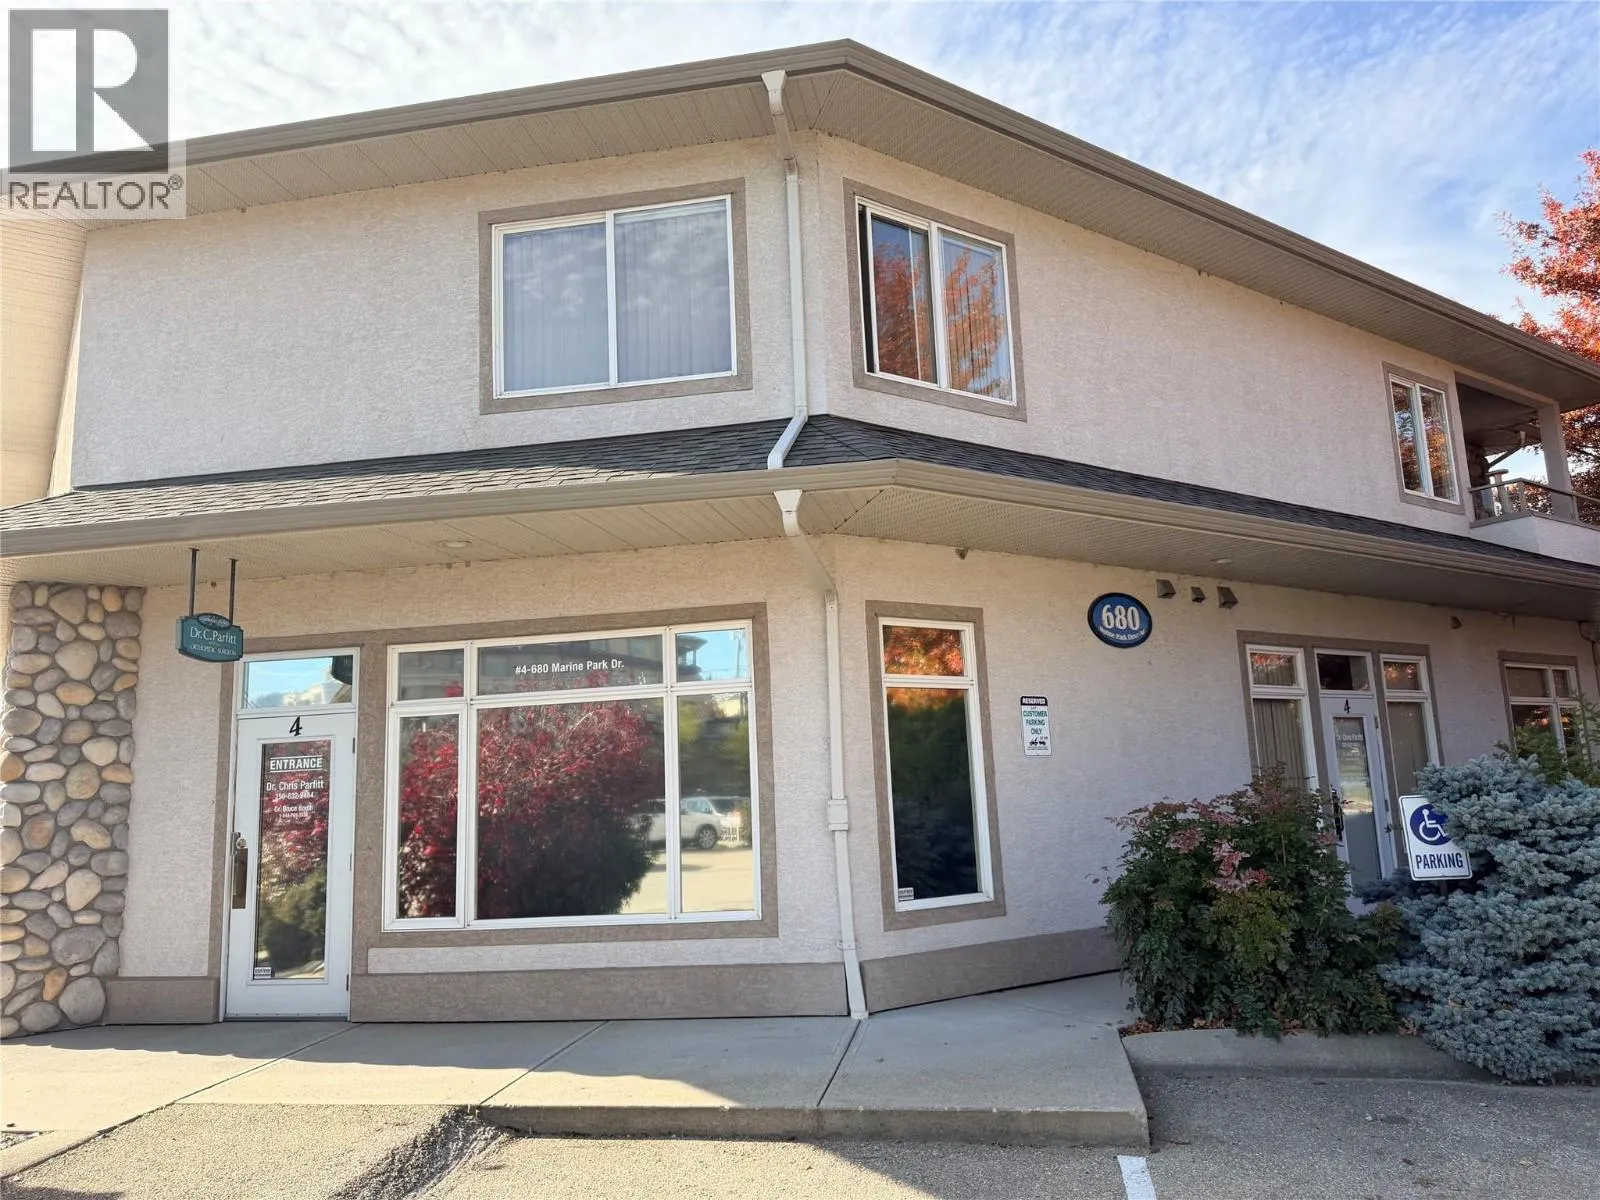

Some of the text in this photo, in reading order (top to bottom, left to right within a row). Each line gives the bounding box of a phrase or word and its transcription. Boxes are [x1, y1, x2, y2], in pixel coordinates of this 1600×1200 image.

[1101, 604, 1140, 631] 680
[515, 659, 625, 674] #4-680 Marine Park Dr.
[1343, 699, 1351, 715] 4
[289, 716, 303, 736] 4
[269, 758, 323, 770] ENTRANCE
[266, 780, 325, 791] Dr. Chris Parfitt
[1415, 852, 1464, 870] PARKING
